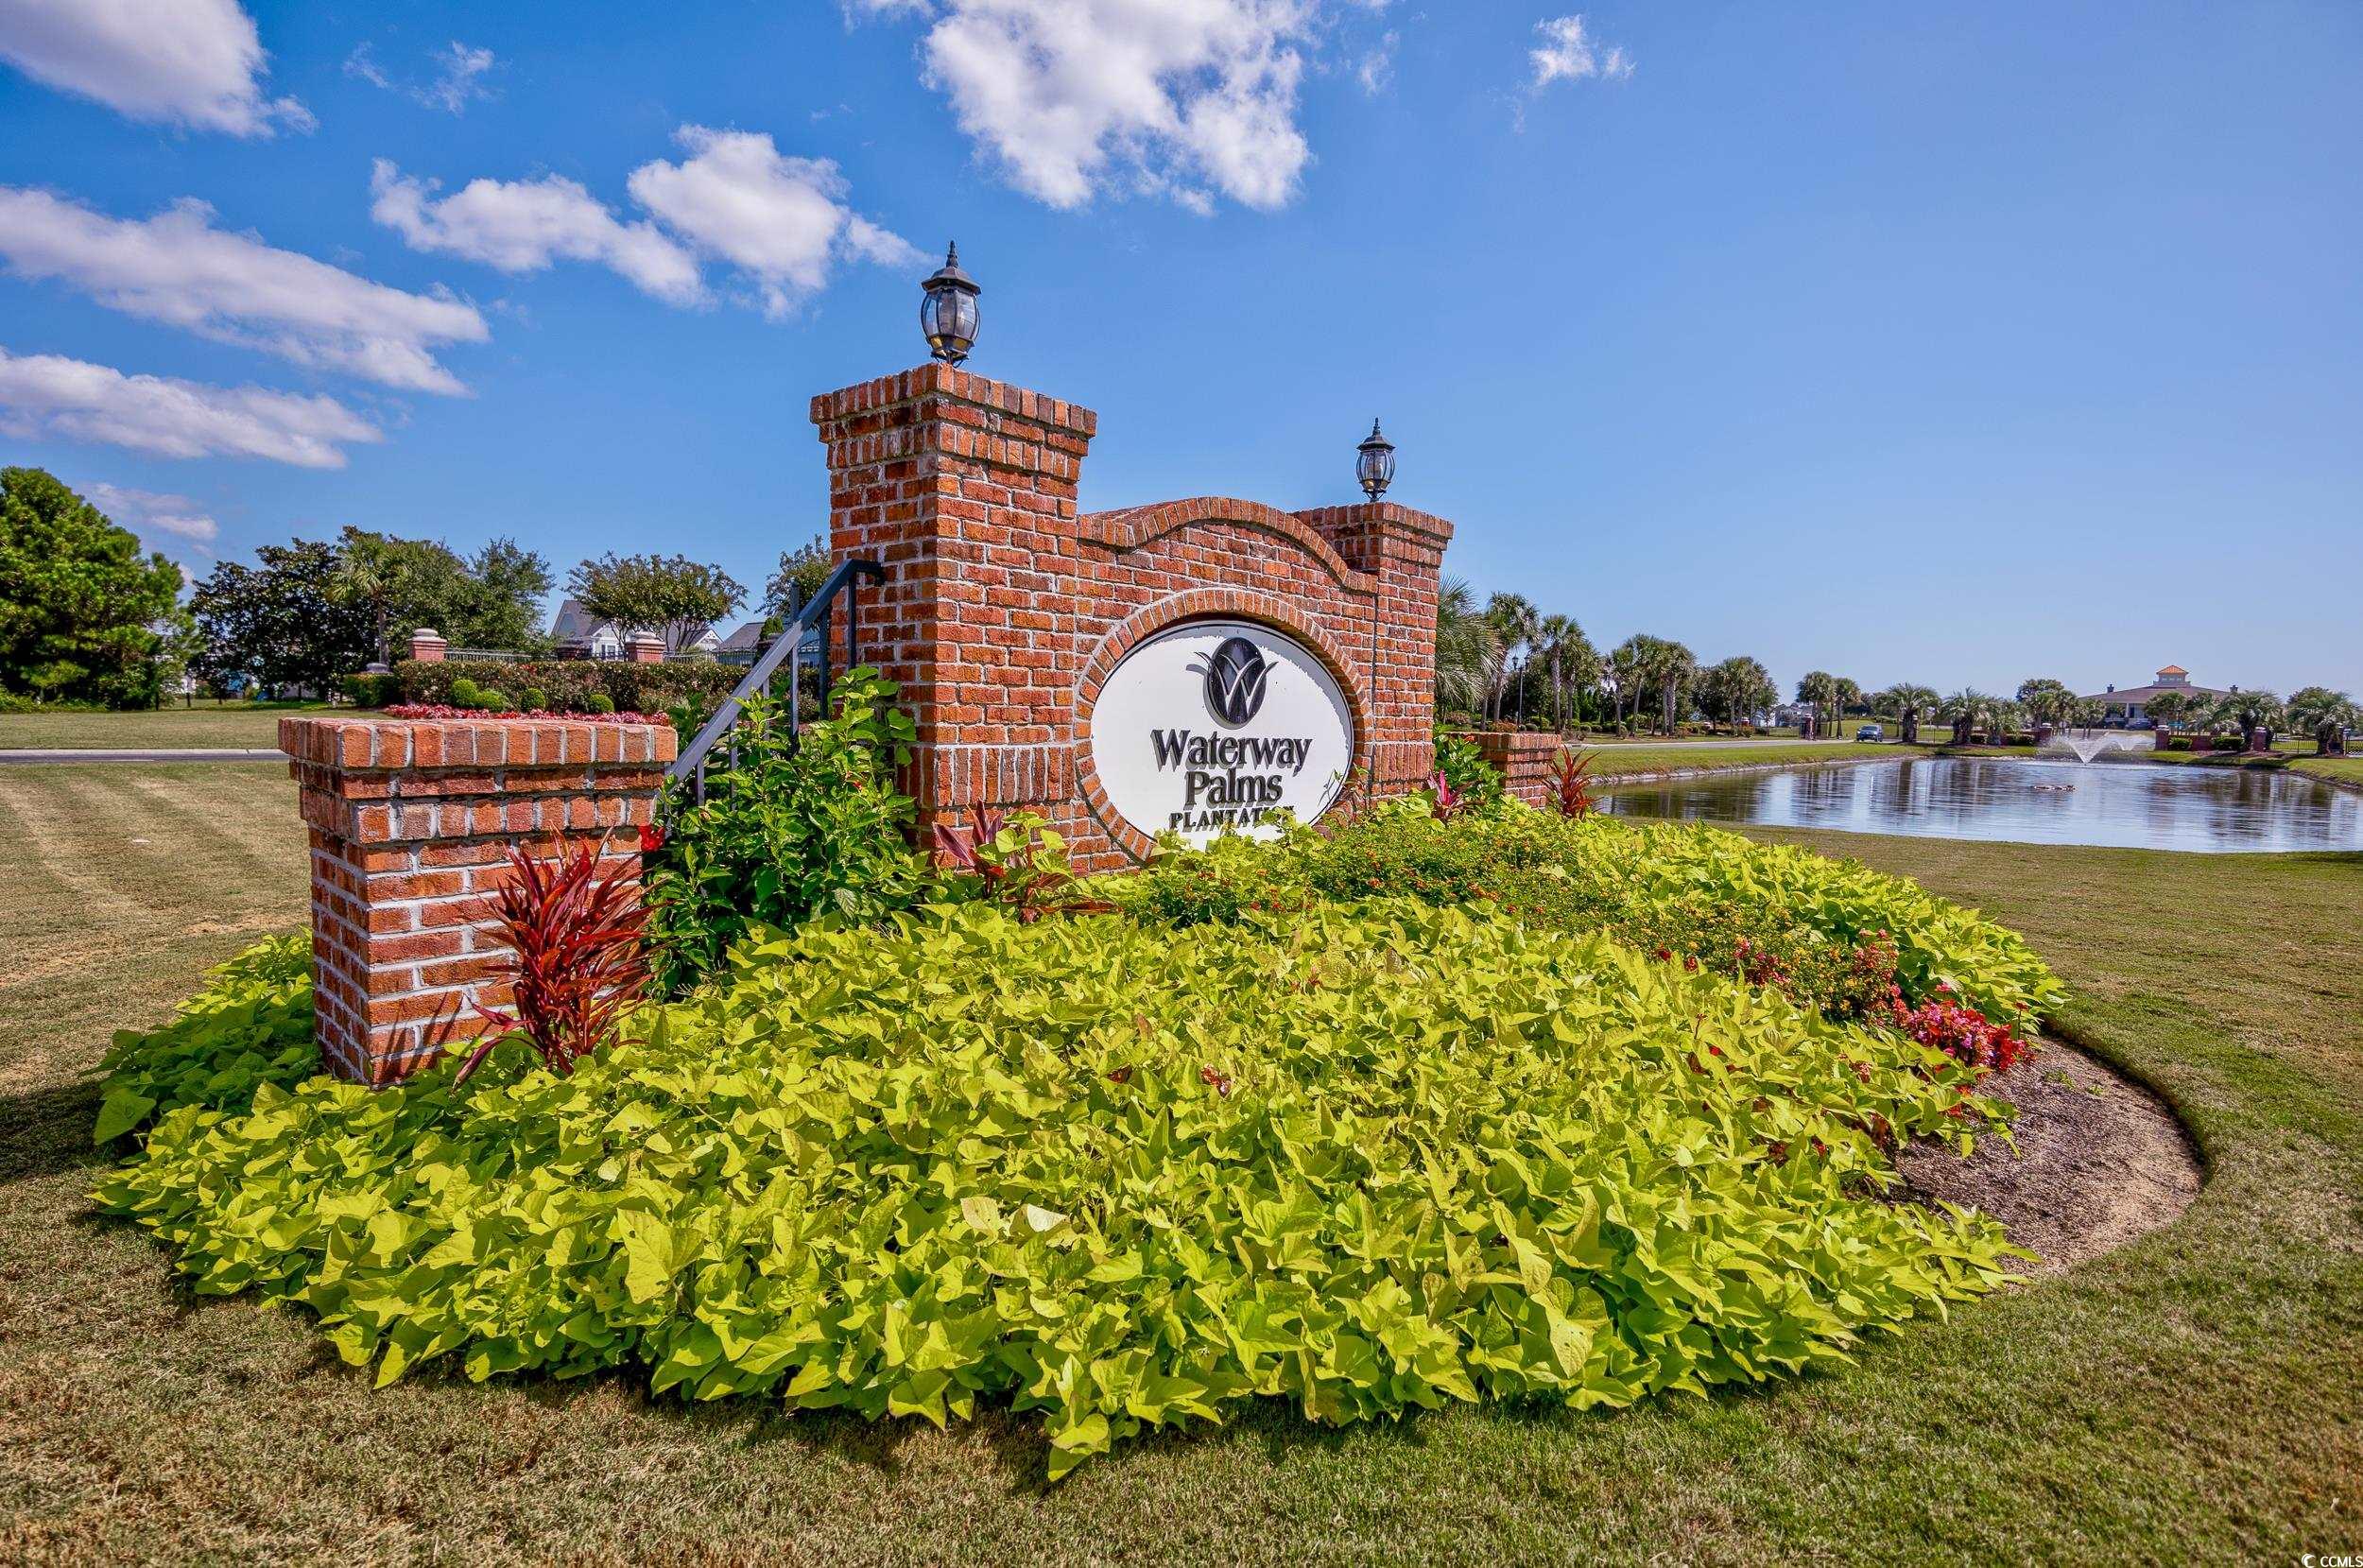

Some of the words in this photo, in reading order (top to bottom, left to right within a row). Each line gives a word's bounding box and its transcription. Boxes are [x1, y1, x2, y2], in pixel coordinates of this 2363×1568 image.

[1150, 729, 1313, 777] Waterway
[1183, 768, 1283, 809] Palms
[1169, 805, 1295, 832] PLANTAT
